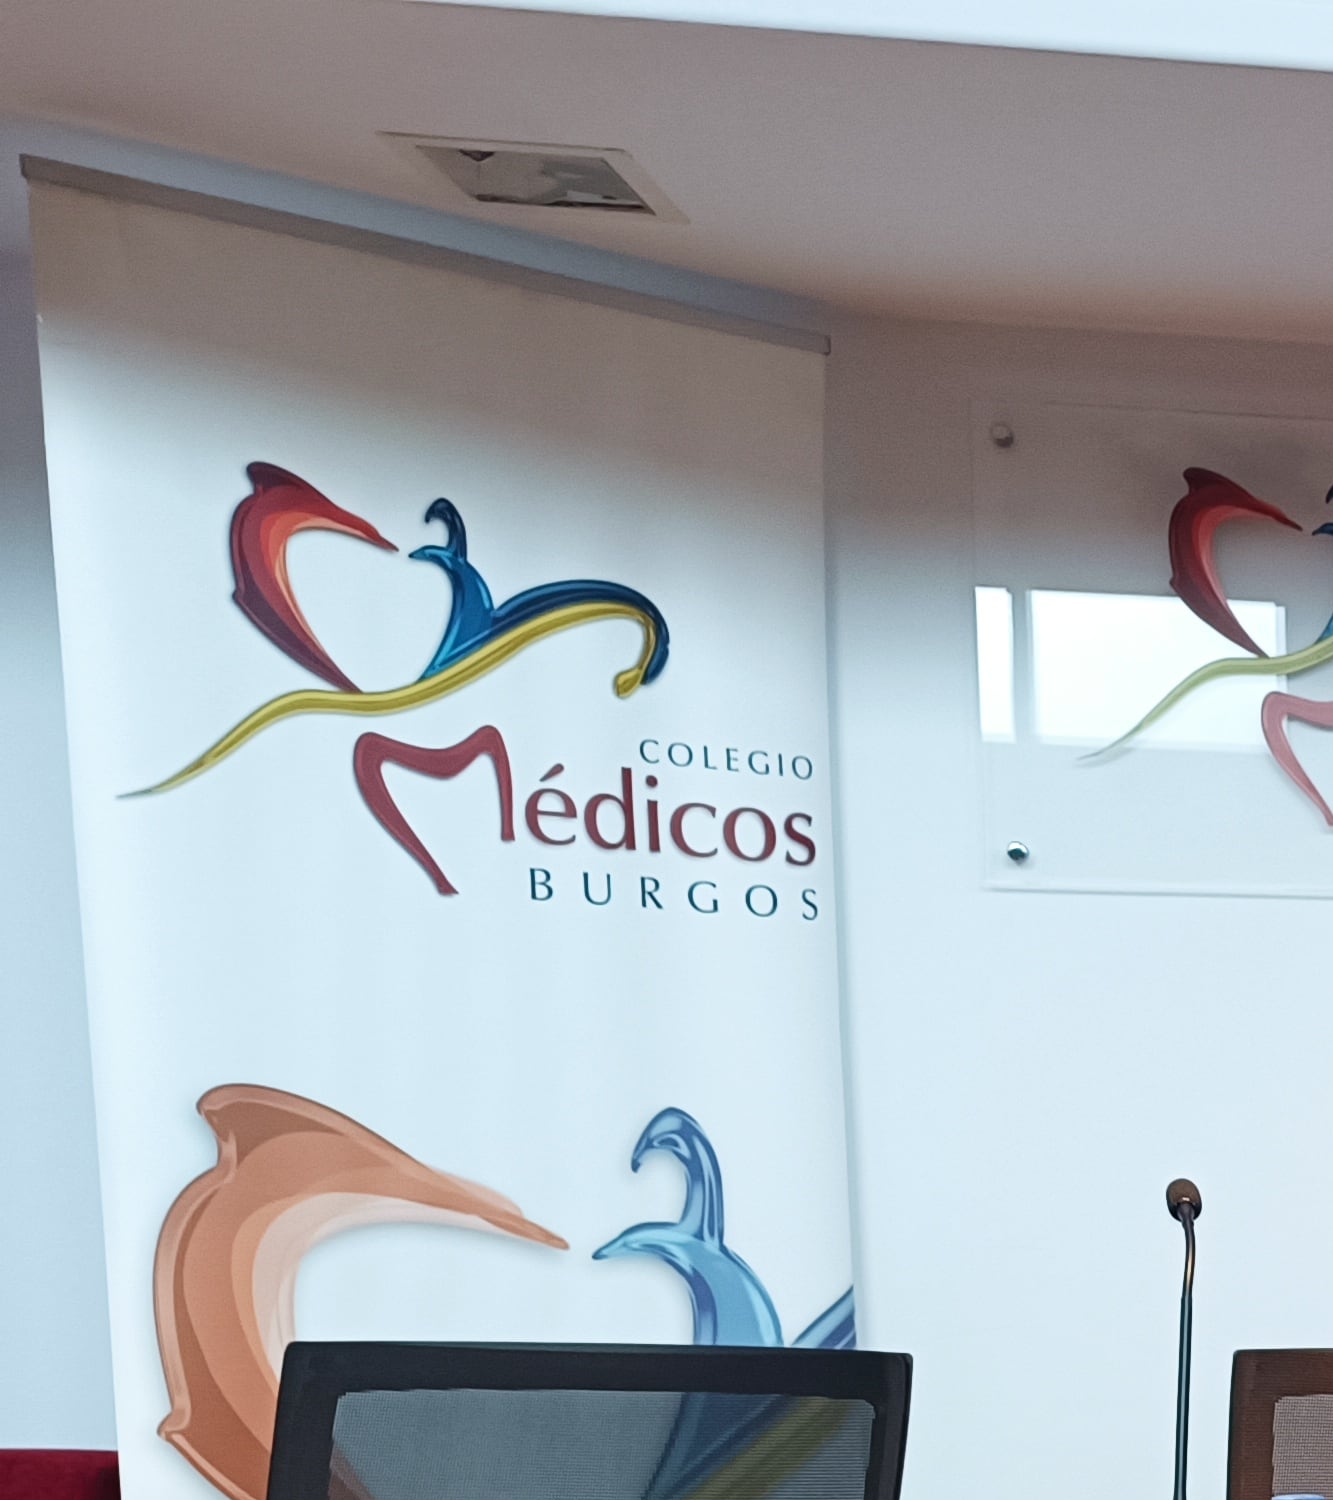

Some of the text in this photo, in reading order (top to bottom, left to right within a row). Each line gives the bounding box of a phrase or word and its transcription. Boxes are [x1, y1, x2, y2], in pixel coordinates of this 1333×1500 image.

[639, 738, 814, 781] COLEGIO
[353, 724, 817, 897] Médicos
[528, 866, 819, 921] BURGOS
